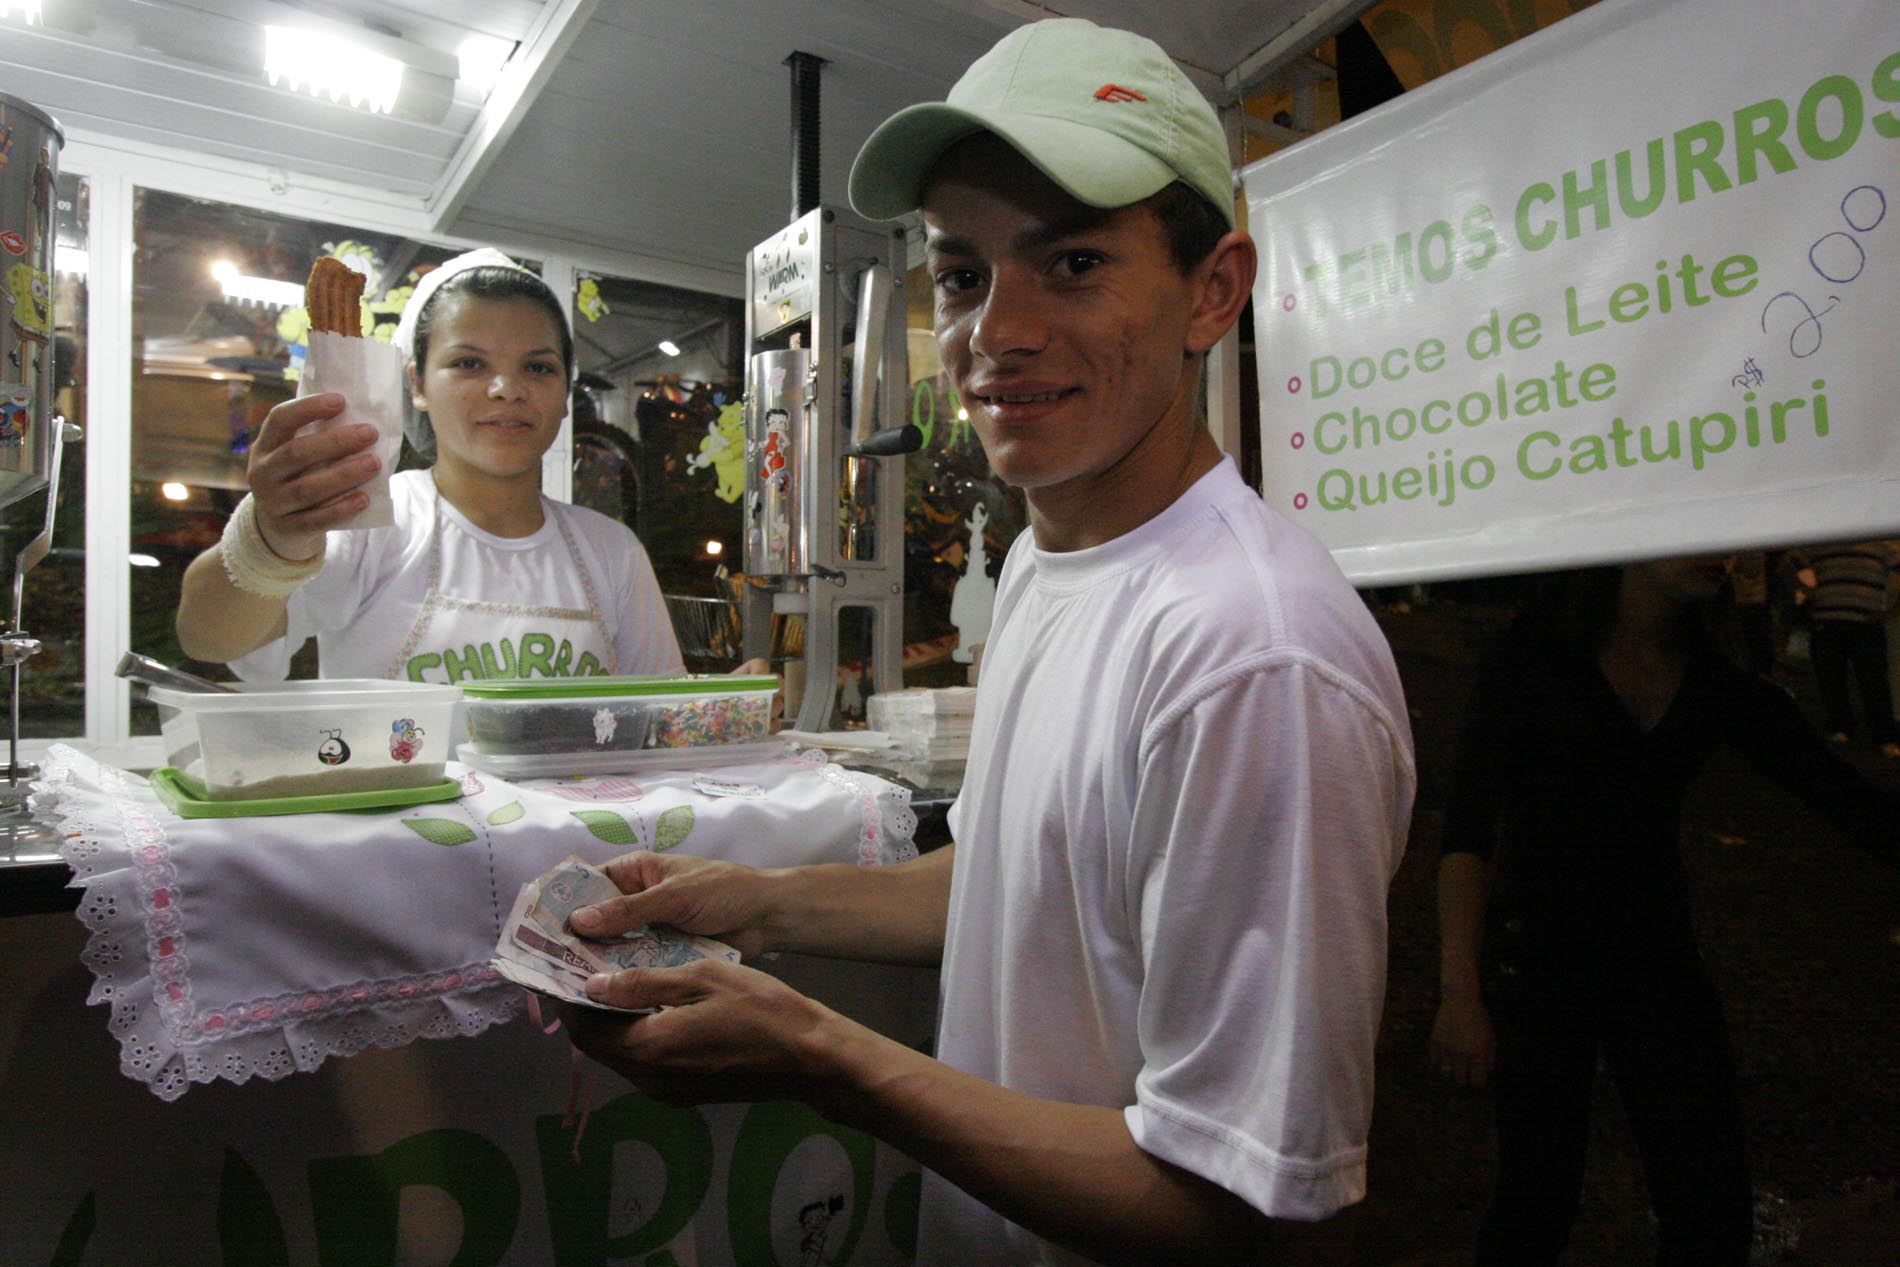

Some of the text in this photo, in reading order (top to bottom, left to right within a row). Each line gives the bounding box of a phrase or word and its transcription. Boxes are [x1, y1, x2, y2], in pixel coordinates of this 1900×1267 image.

[1304, 204, 1499, 320] TEMOS
[1310, 253, 1759, 400] Doce de Leite
[1313, 361, 1617, 455] Chocolate
[1316, 378, 1831, 512] Queijo Catupiri
